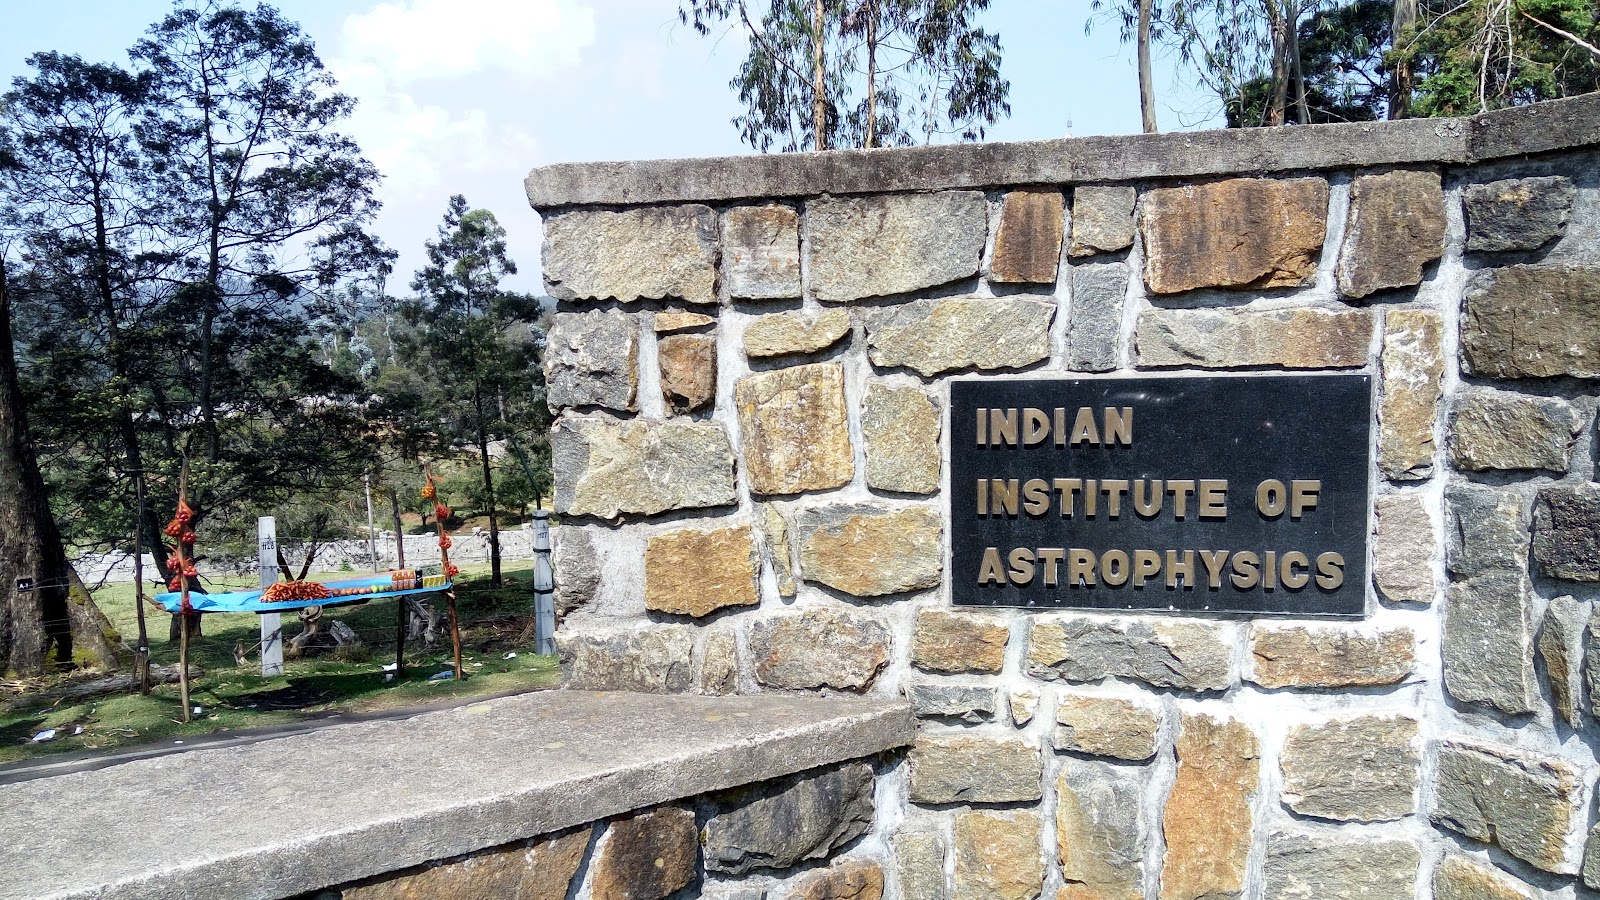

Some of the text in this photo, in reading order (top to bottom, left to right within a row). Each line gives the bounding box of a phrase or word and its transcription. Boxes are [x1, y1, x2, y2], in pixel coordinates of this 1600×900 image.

[976, 406, 1133, 446] INDIAN
[977, 478, 1321, 518] INSTITUTE OF
[977, 546, 1345, 590] ASTROPHYSICS
